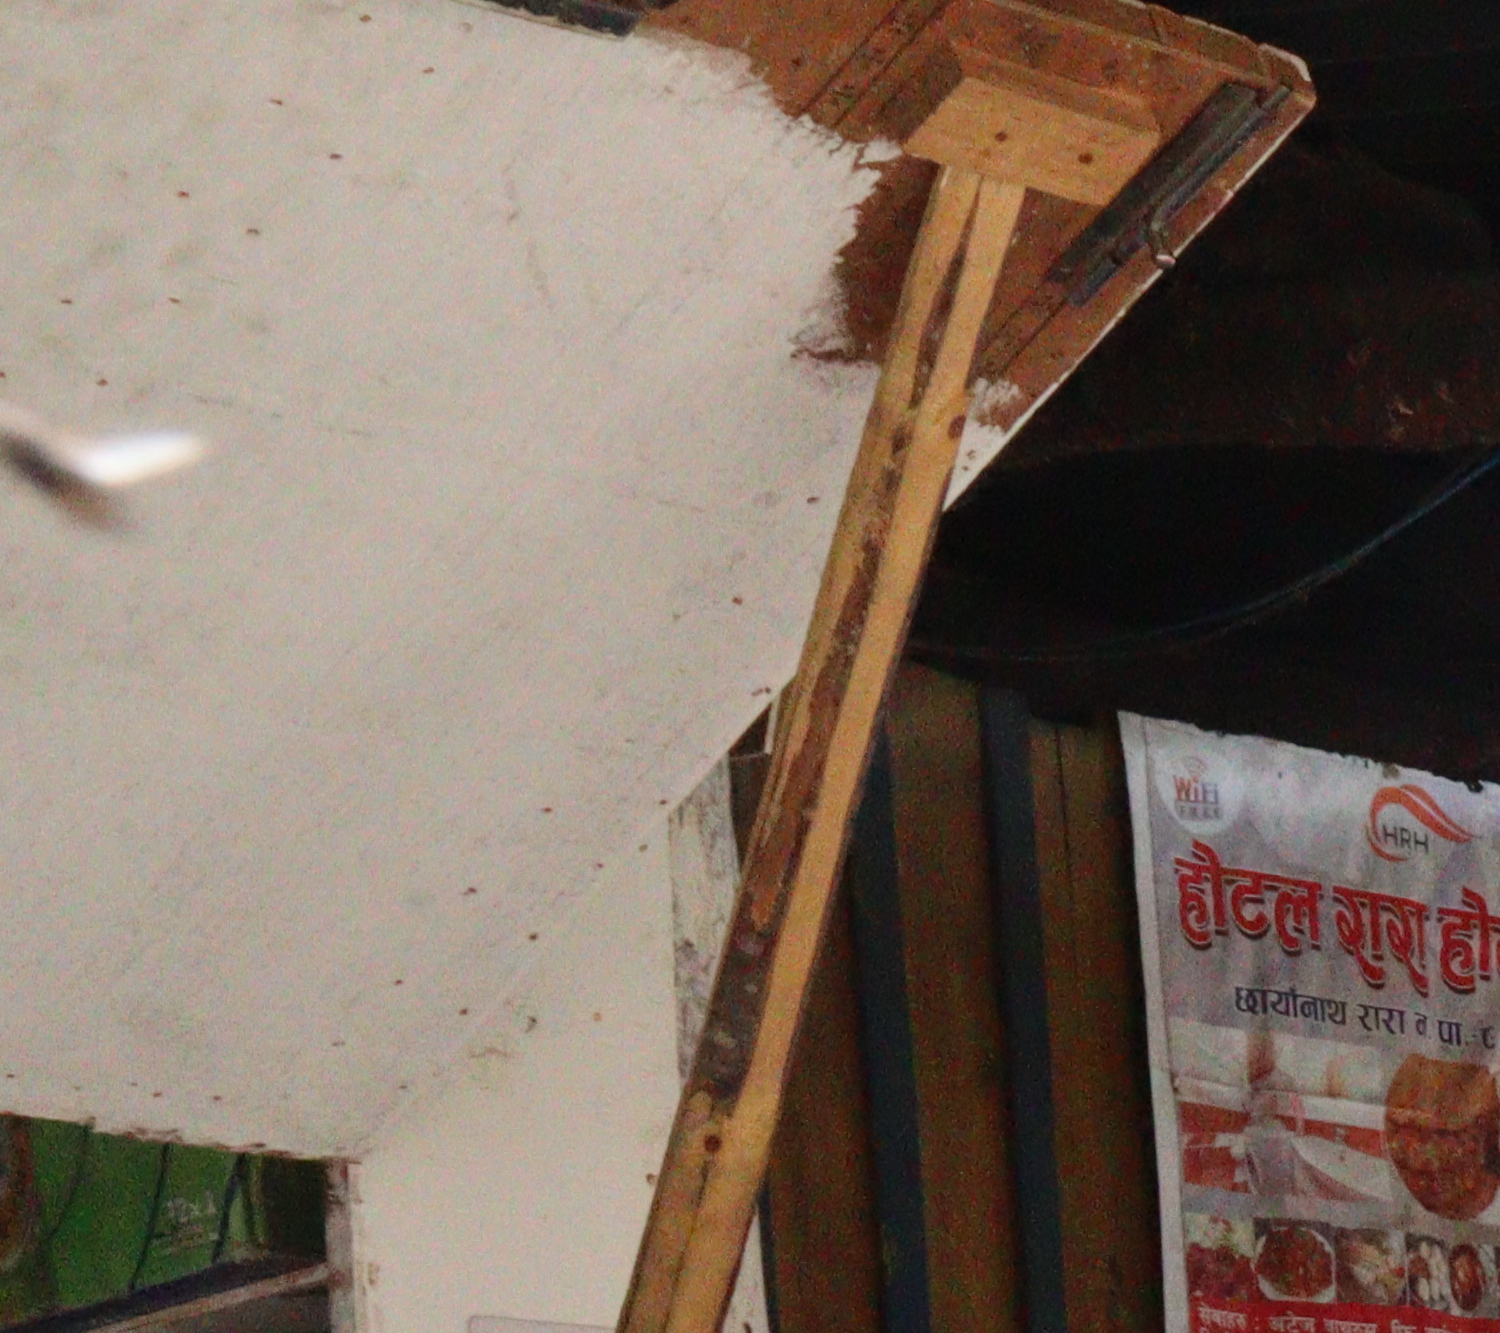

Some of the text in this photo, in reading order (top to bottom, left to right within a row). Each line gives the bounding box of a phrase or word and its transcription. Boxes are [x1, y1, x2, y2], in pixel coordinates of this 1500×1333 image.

[1381, 823, 1431, 853] HRH
[1173, 837, 1323, 955] होटल
[1332, 884, 1430, 997] रारा
[1357, 1003, 1406, 1036] रारा
